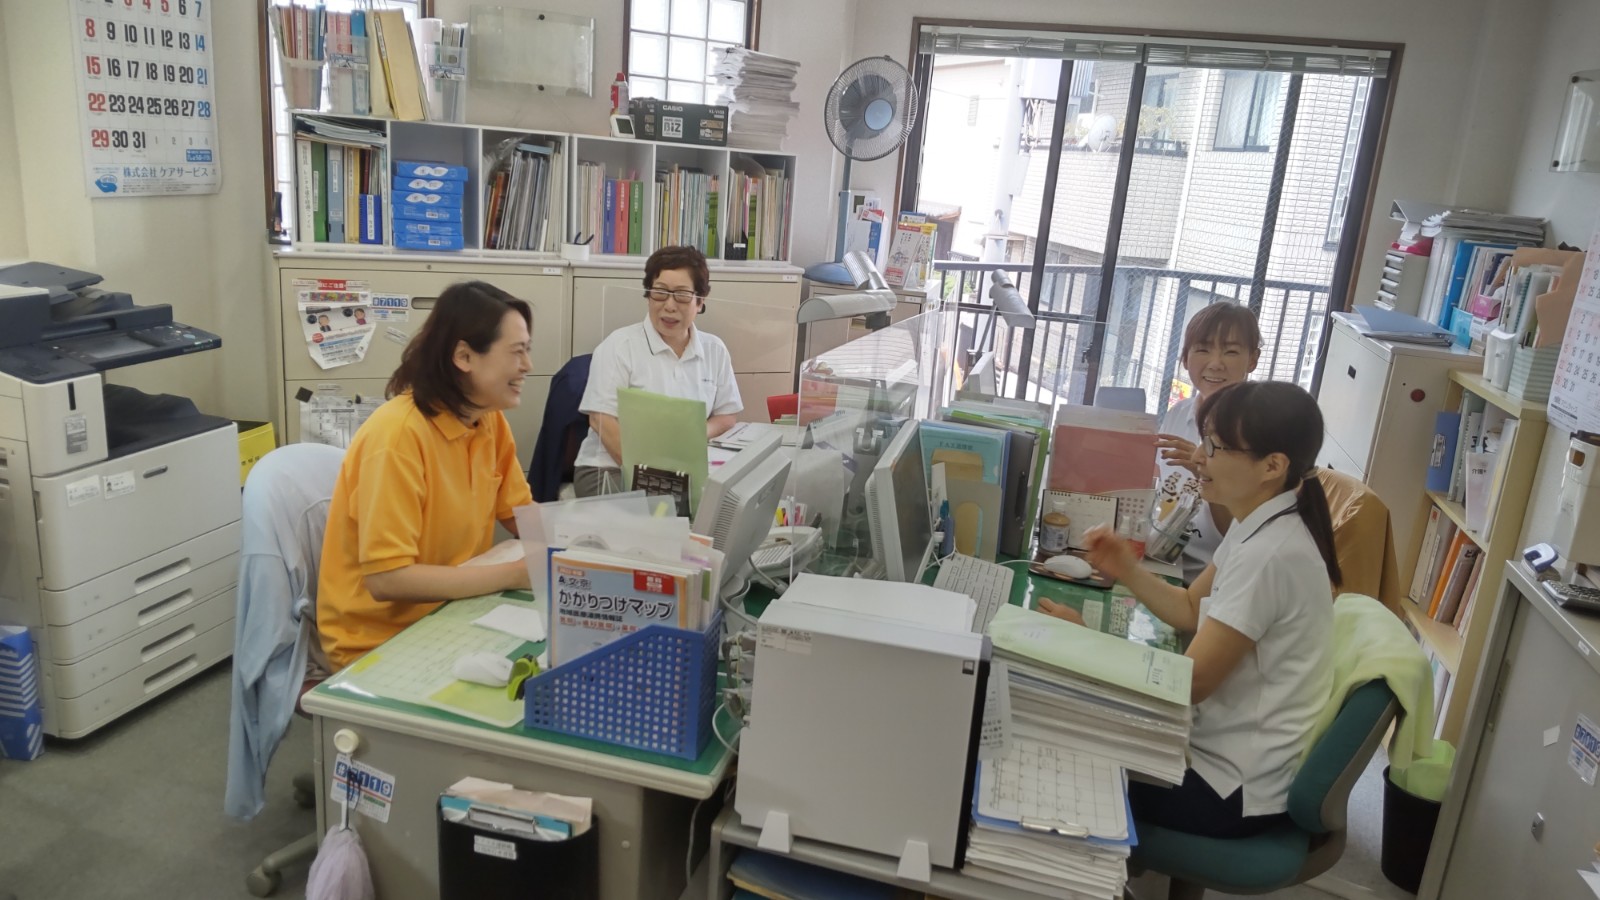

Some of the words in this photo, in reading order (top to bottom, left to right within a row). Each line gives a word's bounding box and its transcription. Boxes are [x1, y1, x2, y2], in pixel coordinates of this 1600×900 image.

[178, 0, 187, 15] 6
[195, 1, 203, 18] 7
[85, 18, 95, 38] 8
[106, 21, 116, 40] 9
[124, 24, 137, 43] 10
[143, 27, 155, 45] 11
[161, 29, 173, 48] 12
[178, 32, 190, 50] 13
[195, 34, 205, 51] 14
[86, 55, 101, 75] 15
[107, 58, 121, 77] 16
[127, 60, 139, 78] 17
[145, 62, 158, 80] 18
[163, 64, 175, 82] 19
[178, 66, 194, 84] 20
[197, 68, 208, 85] 21
[88, 93, 106, 112] 22
[109, 94, 126, 113] 23
[128, 96, 144, 114] 24
[147, 97, 162, 115] 25
[164, 99, 179, 116] 26
[181, 100, 195, 117] 27
[198, 101, 211, 118] 28
[92, 129, 110, 148] 29
[112, 130, 129, 148] 30
[133, 131, 146, 148] 31
[123, 167, 157, 178] 株式会社
[160, 167, 209, 178] ケアサービス
[559, 589, 673, 619] かかりつけマップ
[337, 762, 391, 796] #119
